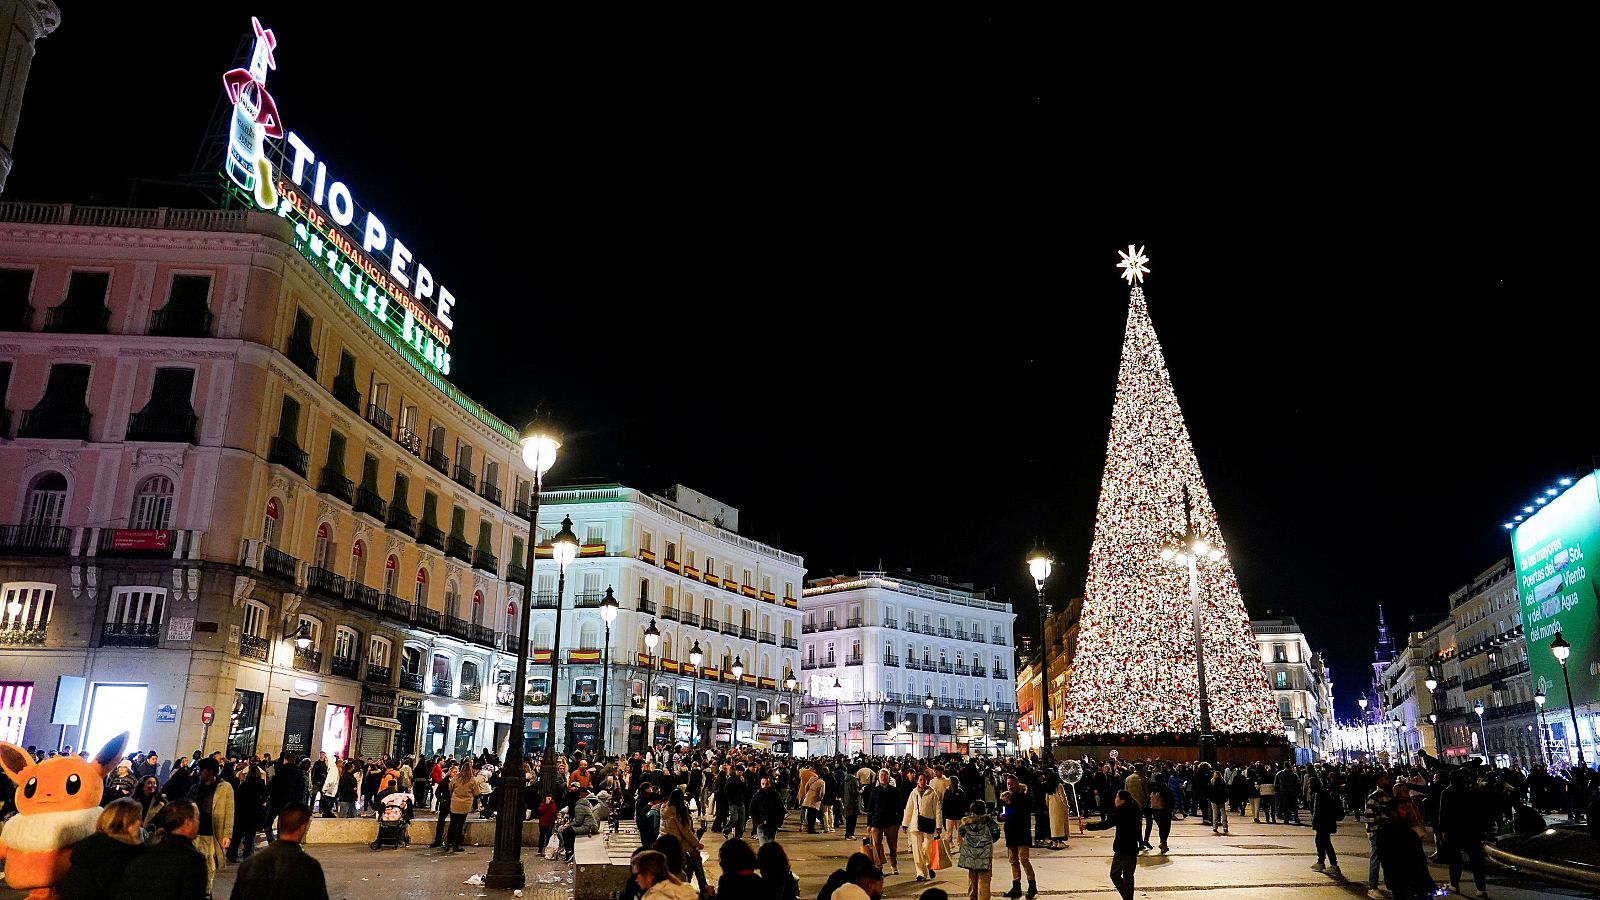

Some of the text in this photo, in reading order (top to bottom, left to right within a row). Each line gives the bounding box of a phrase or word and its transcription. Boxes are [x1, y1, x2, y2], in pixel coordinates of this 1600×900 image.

[287, 131, 455, 330] TIO PEPE
[277, 181, 450, 346] SOL DE ANDALUCIA EMBOTELLADO
[1536, 540, 1562, 561] mayores
[1522, 569, 1545, 589] Puertas
[1545, 559, 1555, 577] del
[1526, 566, 1585, 606] del Viento
[1532, 606, 1542, 622] del
[1562, 592, 1579, 611] Agua
[1531, 625, 1540, 642] del
